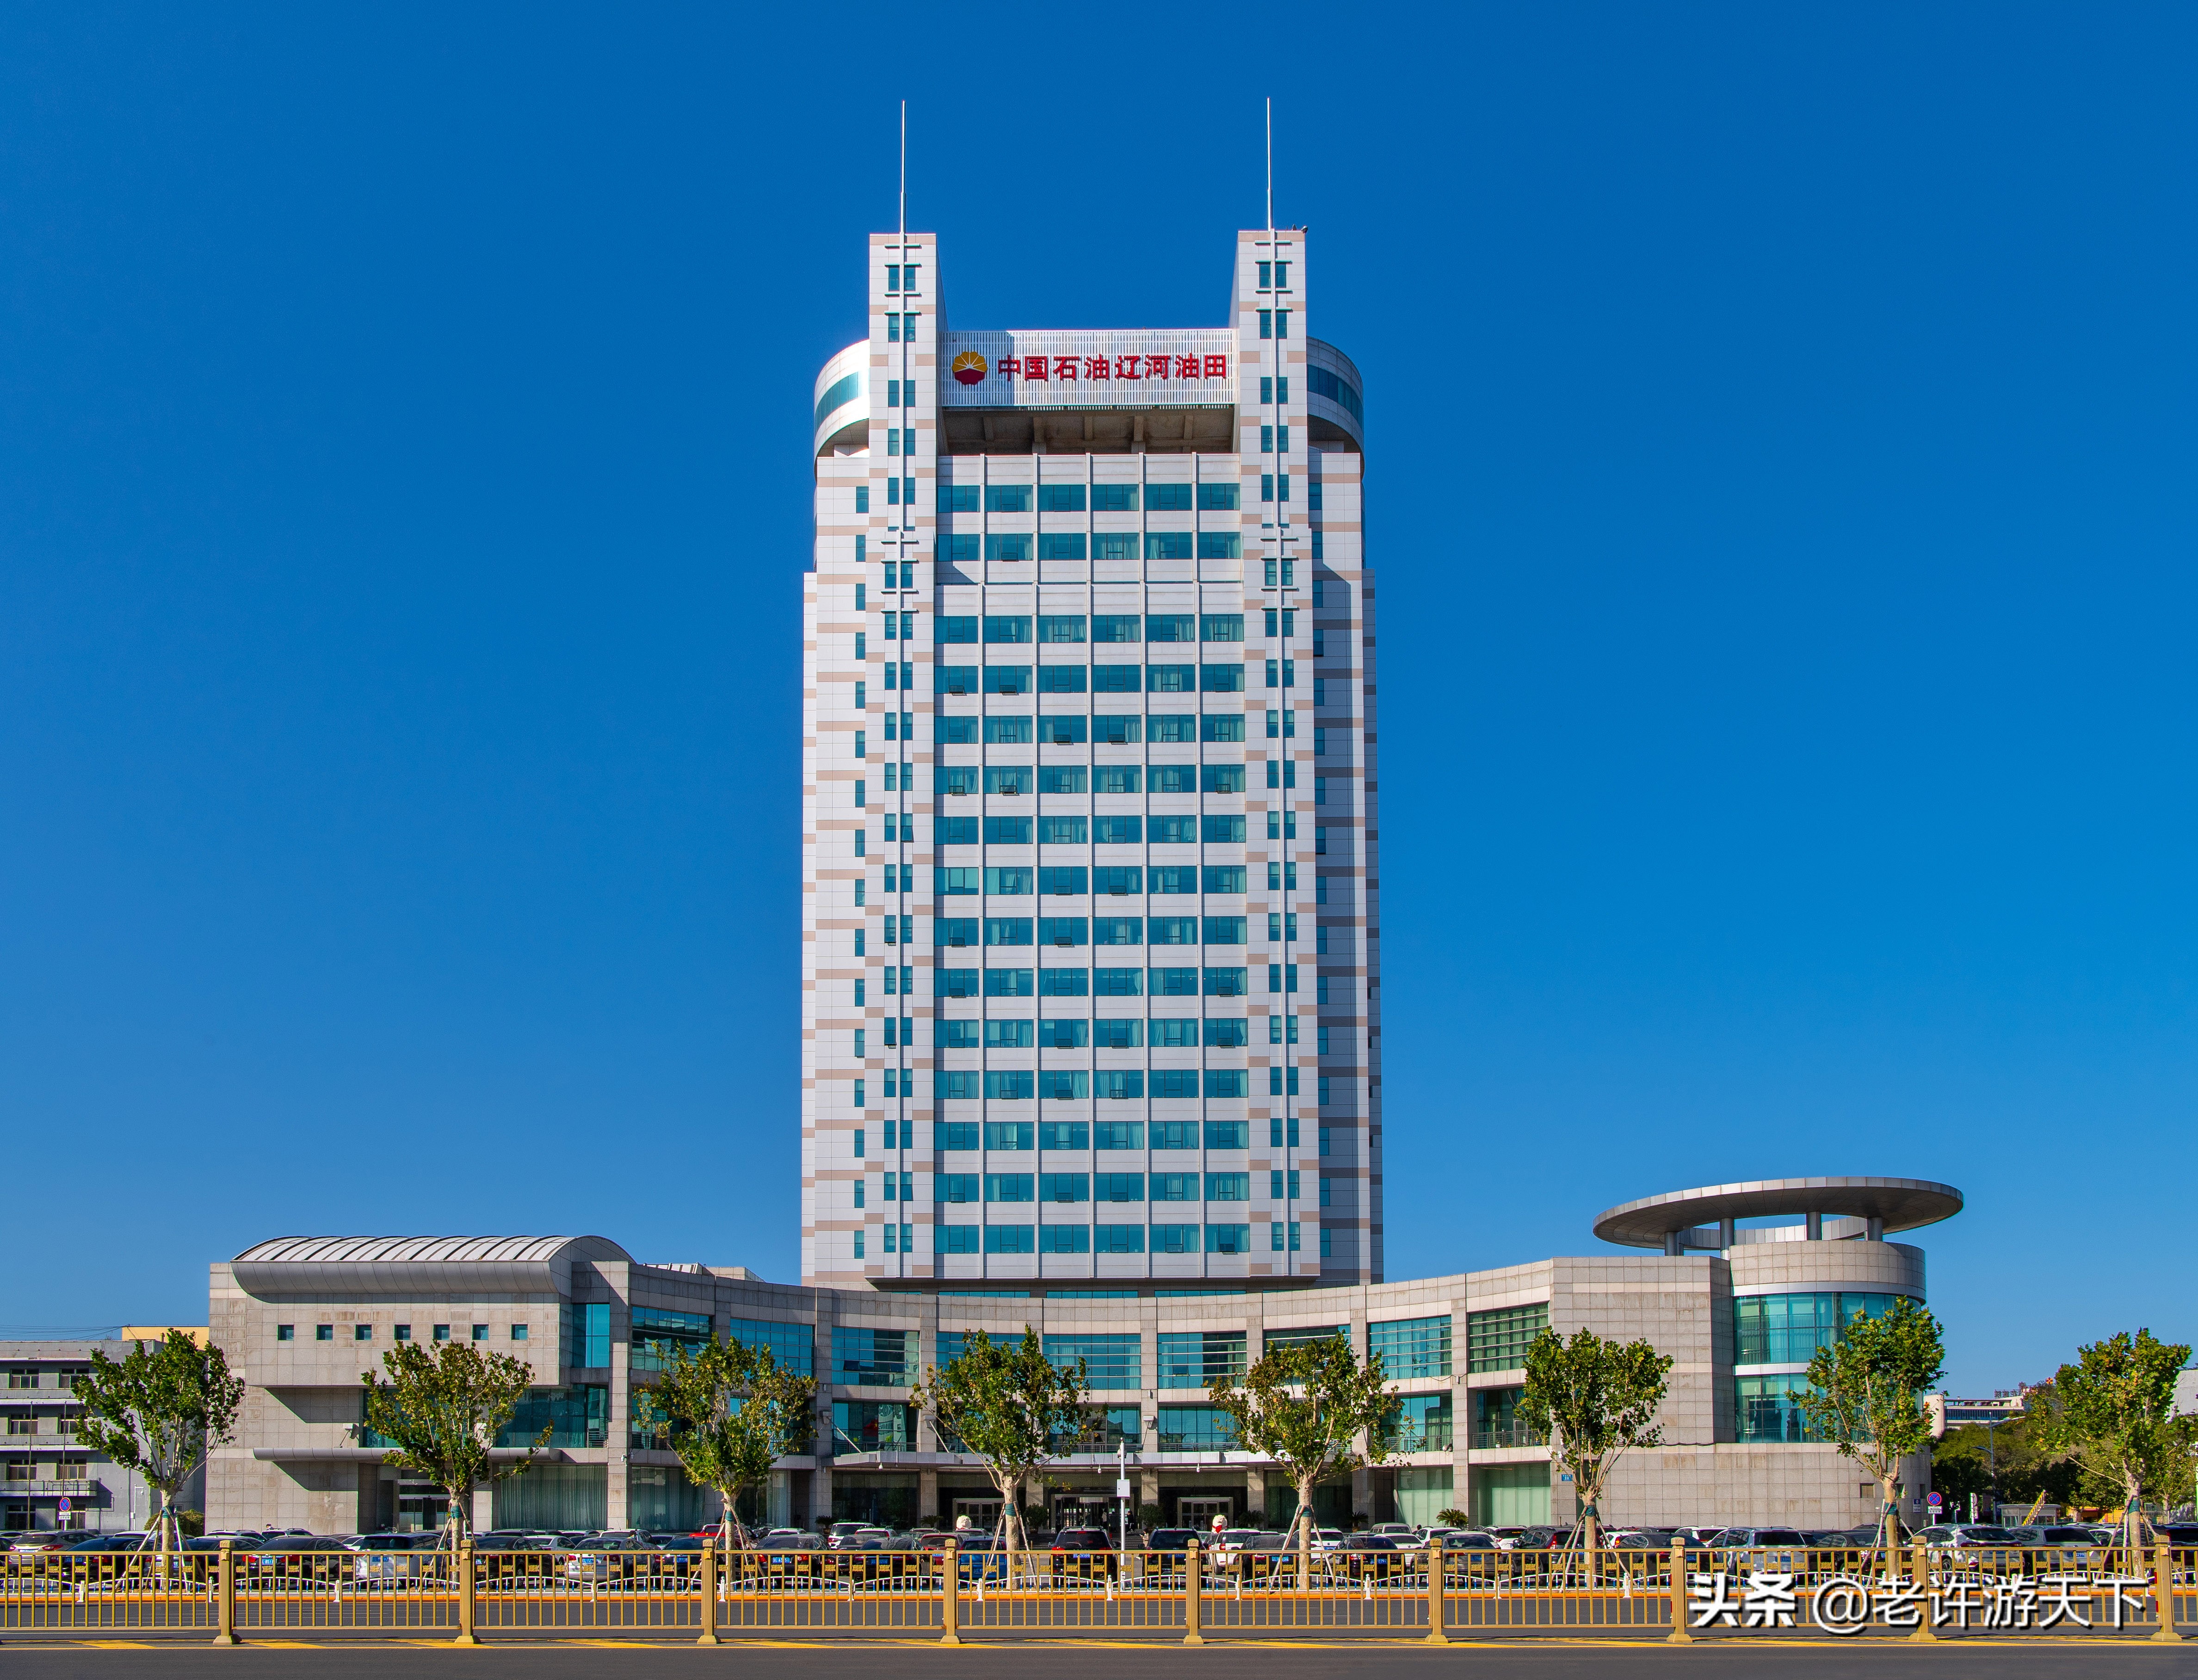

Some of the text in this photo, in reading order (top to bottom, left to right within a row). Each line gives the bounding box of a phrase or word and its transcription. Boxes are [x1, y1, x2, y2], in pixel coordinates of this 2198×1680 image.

[997, 353, 1227, 382] 中国石油辽河油田
